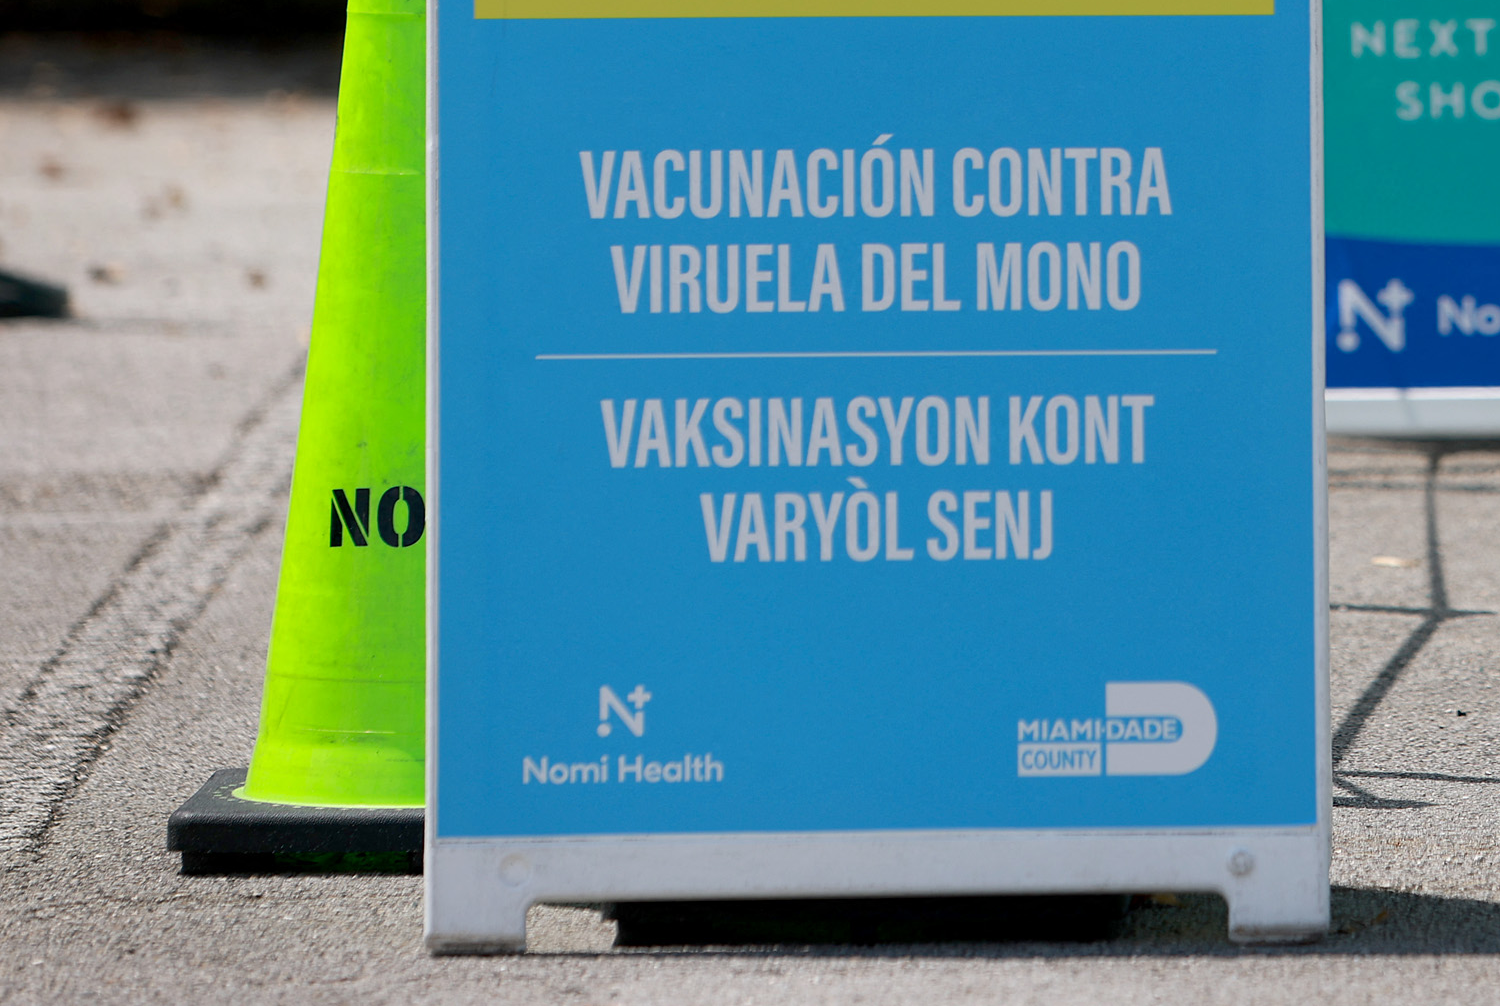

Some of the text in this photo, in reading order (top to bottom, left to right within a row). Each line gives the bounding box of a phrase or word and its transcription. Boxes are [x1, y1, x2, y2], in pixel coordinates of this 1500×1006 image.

[1349, 17, 1496, 60] NEXT
[578, 133, 1174, 220] VACUNACIÓN CONTRA
[609, 240, 1142, 315] VIRUELA DEL MONO
[599, 394, 1156, 469] VAKSINASYON KONT
[329, 485, 426, 548] NO
[699, 476, 1054, 563] VARYÒL SENJ
[521, 752, 725, 785] Nomi Health
[1021, 749, 1098, 771] COUNTY
